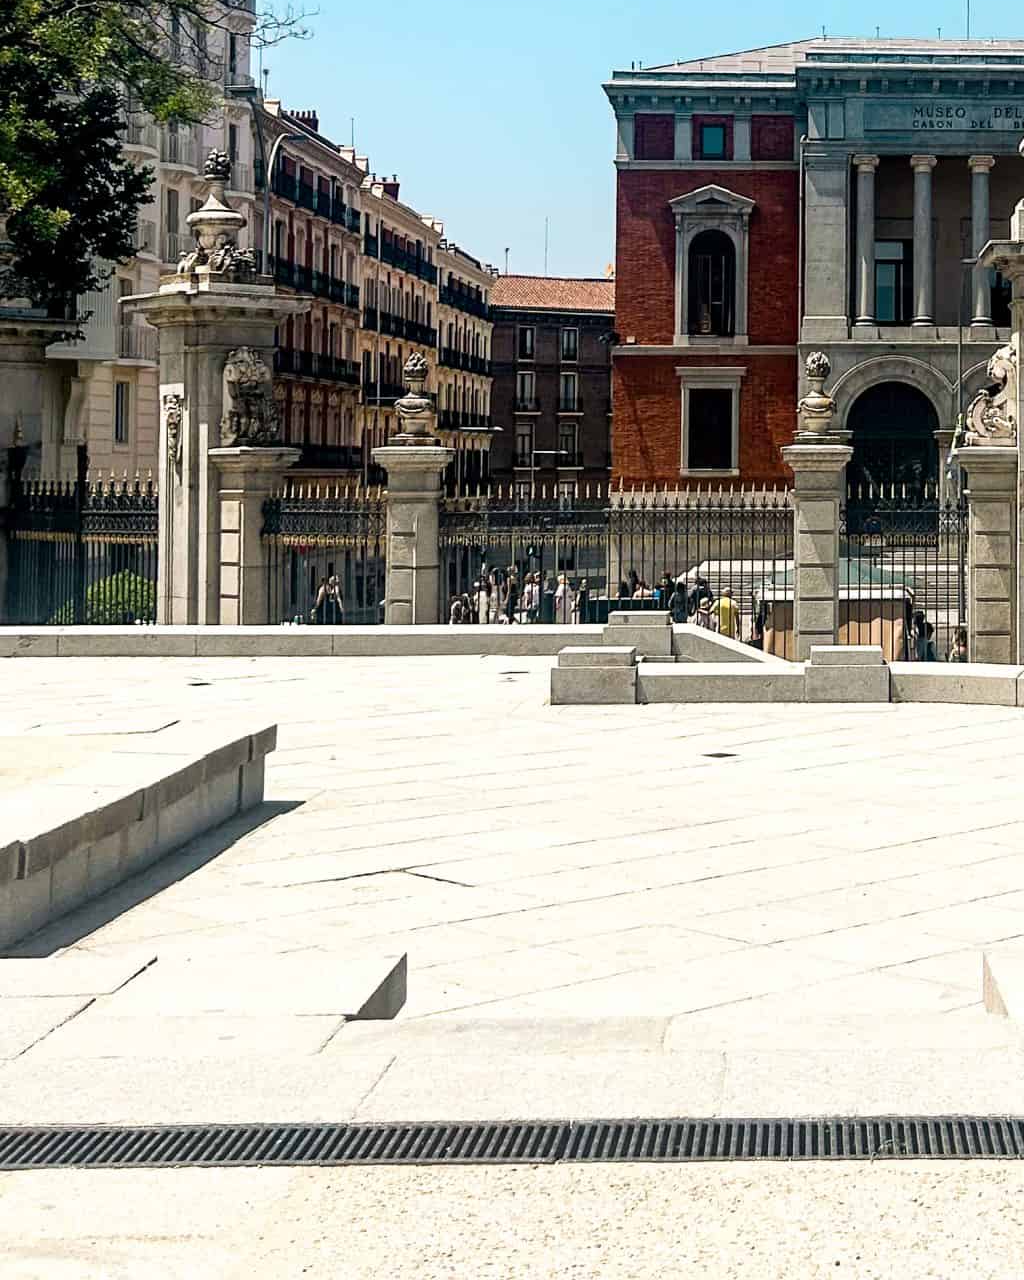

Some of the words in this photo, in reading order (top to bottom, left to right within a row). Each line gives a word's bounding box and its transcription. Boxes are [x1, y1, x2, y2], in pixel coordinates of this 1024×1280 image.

[913, 106, 966, 119] MUSEO
[993, 106, 1023, 119] DEL
[971, 120, 993, 128] DEL
